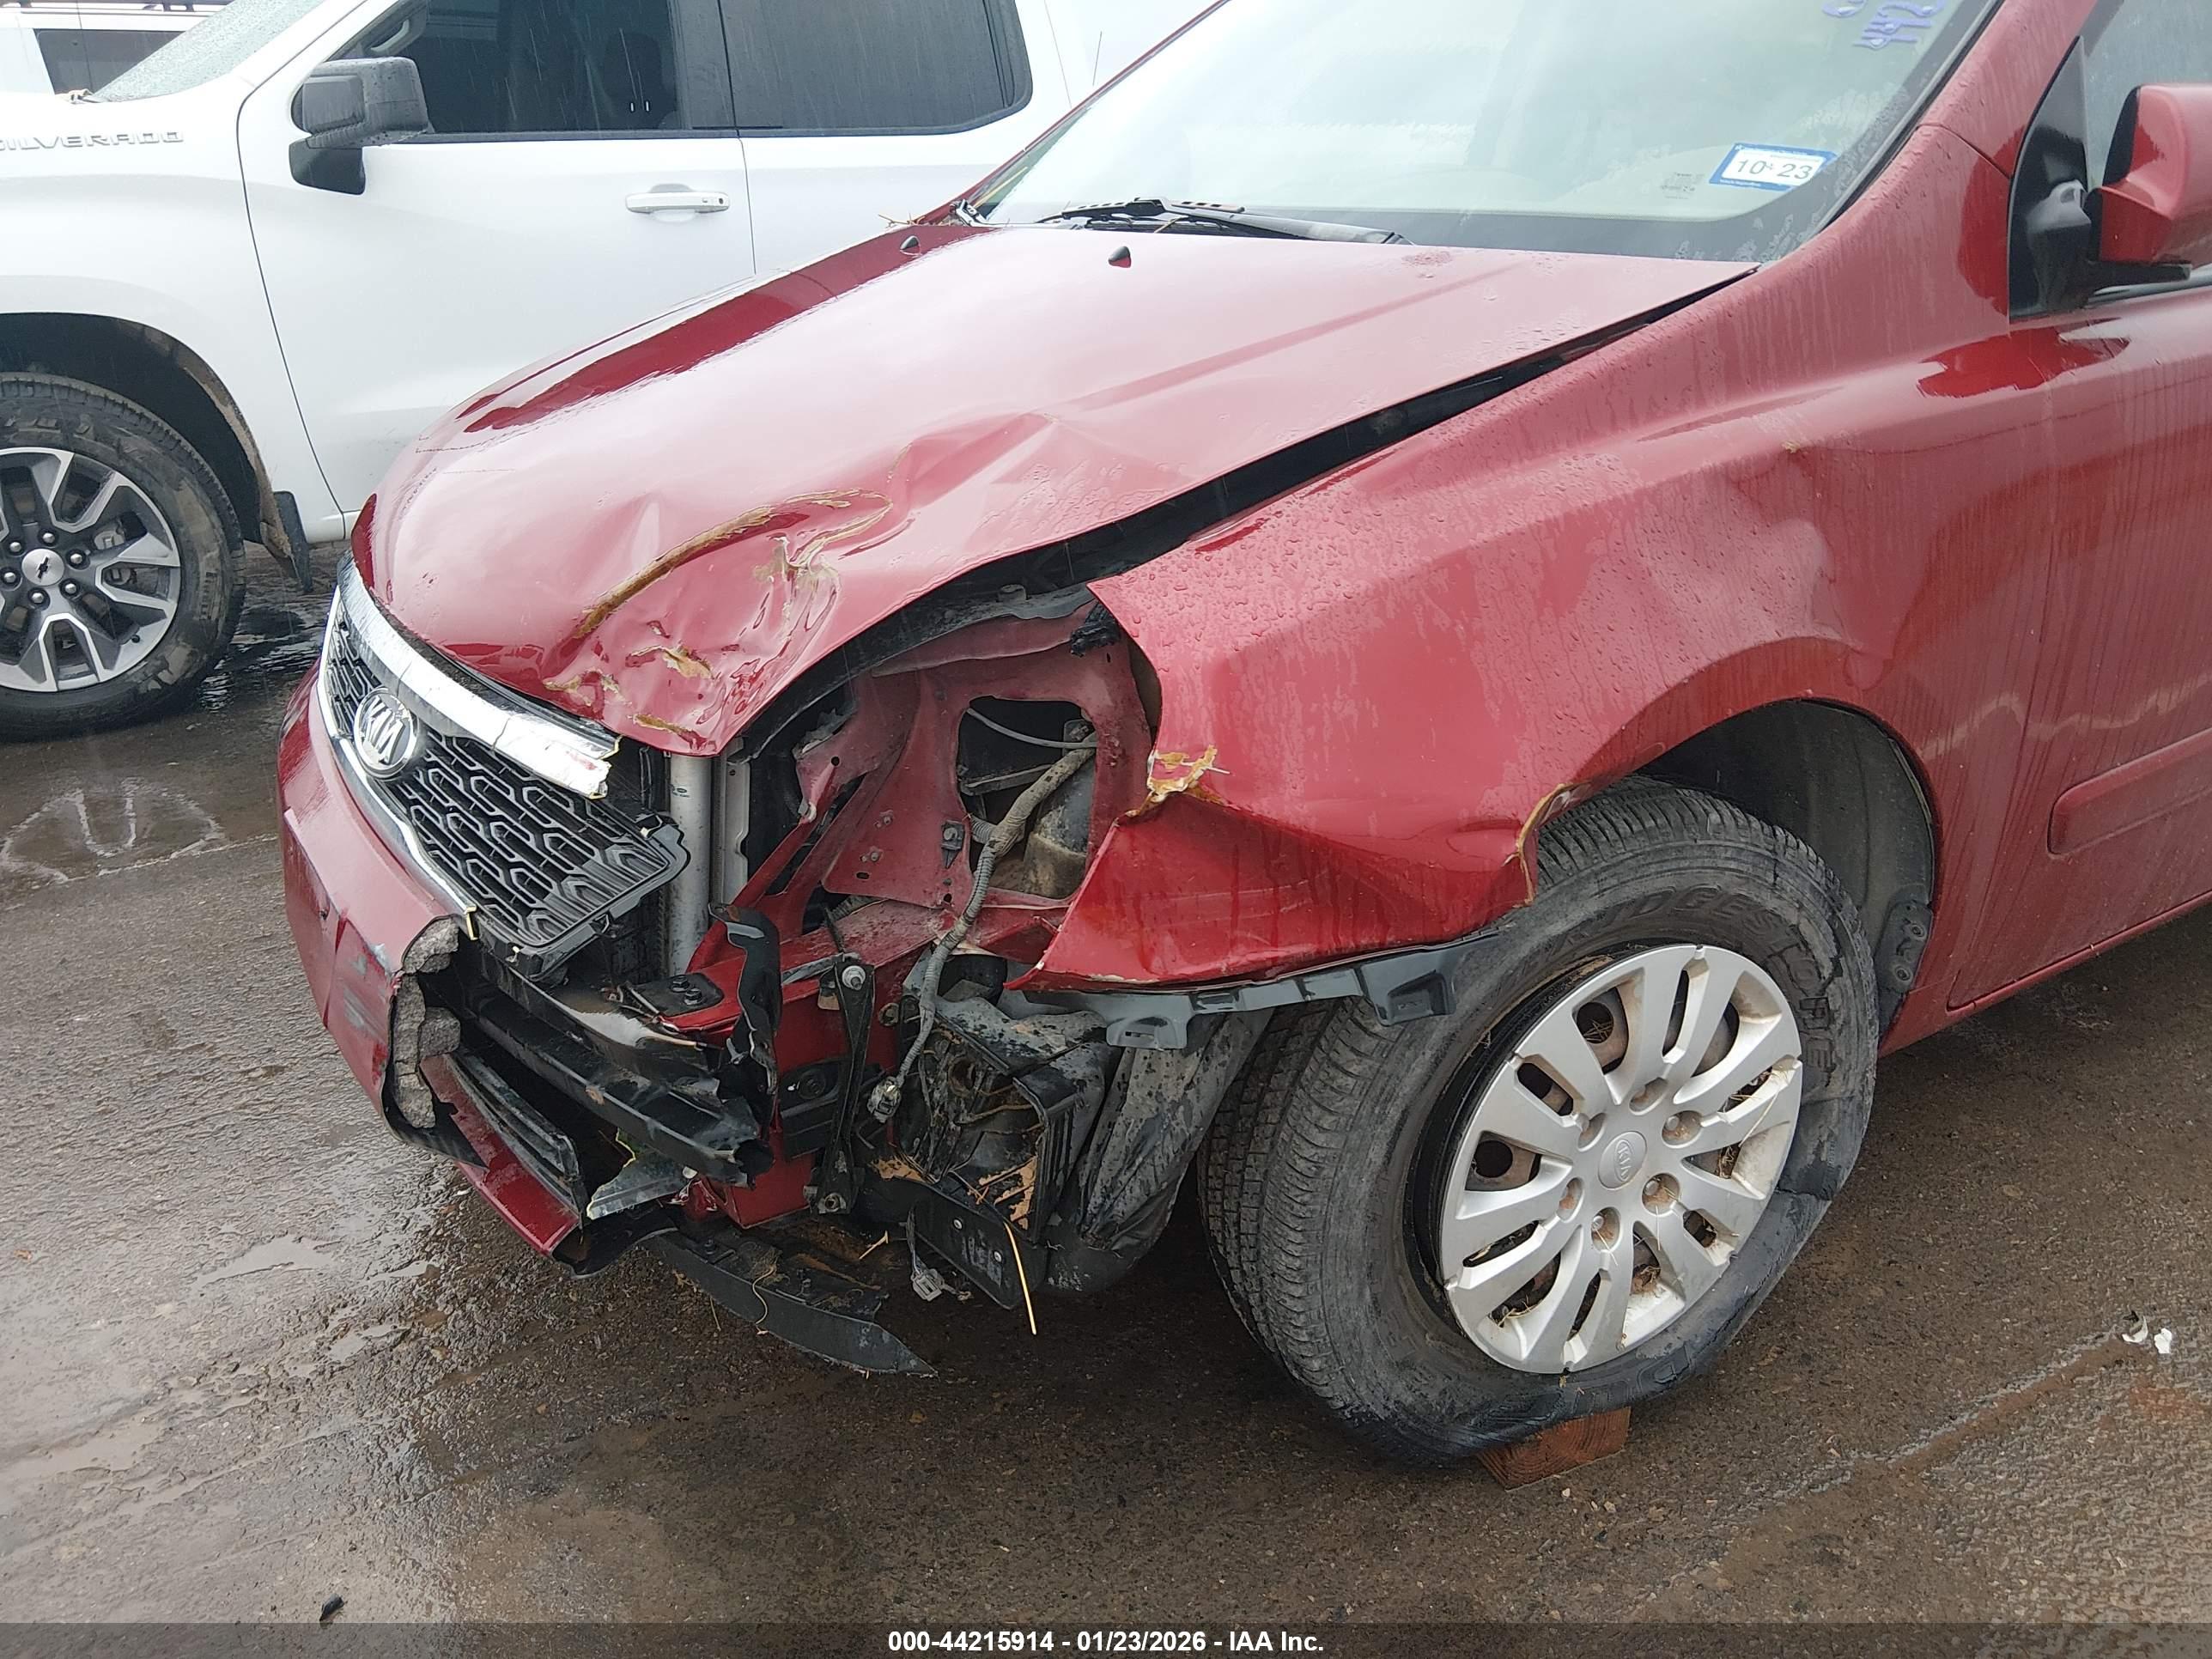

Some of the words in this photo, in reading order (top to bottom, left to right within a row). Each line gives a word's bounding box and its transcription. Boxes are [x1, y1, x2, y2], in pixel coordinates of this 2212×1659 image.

[0, 131, 184, 151] ILVERADO
[1737, 159, 1767, 175] 10
[1777, 162, 1813, 179] 23
[362, 694, 404, 766] KIA
